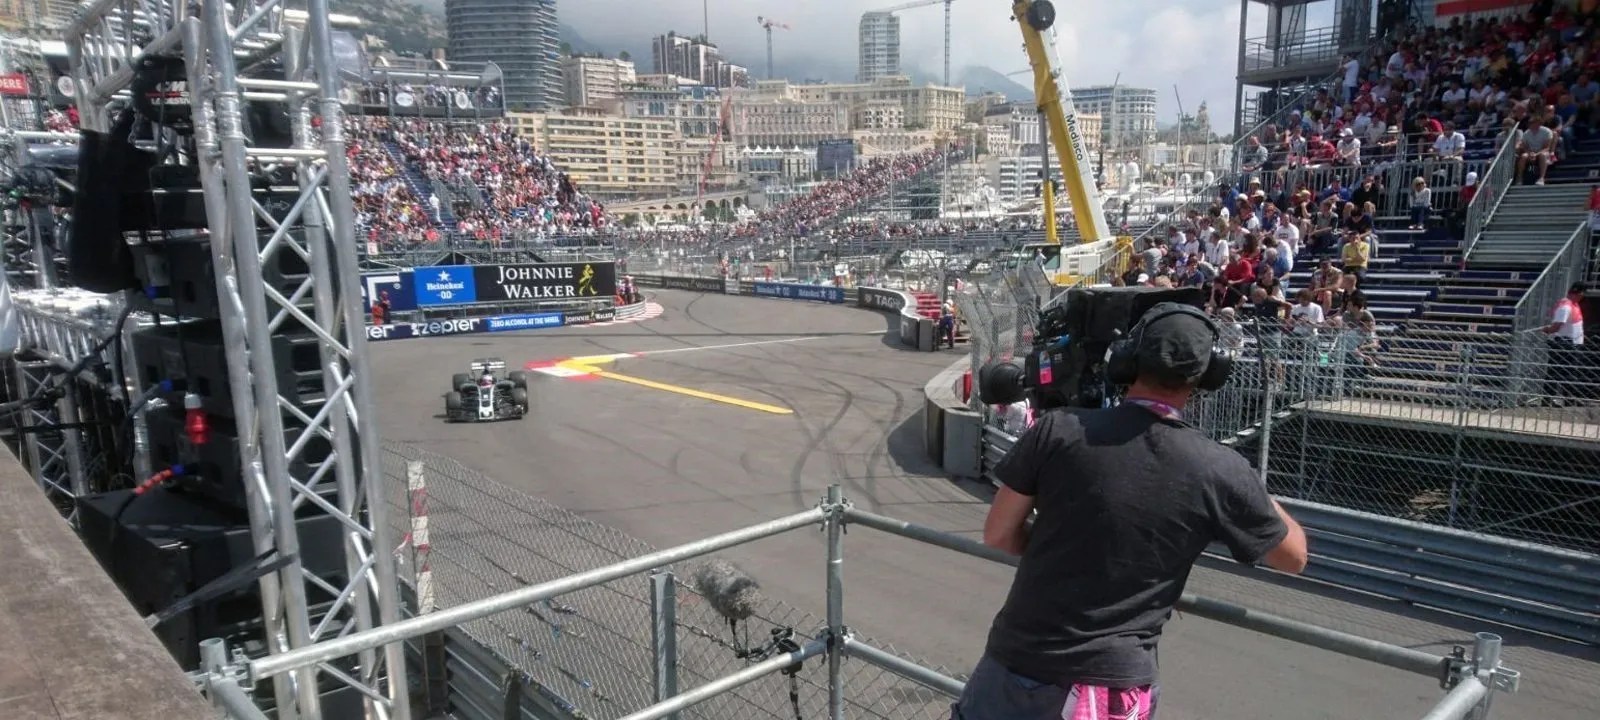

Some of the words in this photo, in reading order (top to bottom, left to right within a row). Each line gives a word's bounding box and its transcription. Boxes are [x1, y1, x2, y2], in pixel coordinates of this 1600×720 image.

[1065, 114, 1083, 161] Mediaco
[496, 265, 574, 284] JOHNNIE
[426, 281, 465, 291] Heineken
[503, 284, 576, 299] WALKER
[419, 318, 480, 334] zepter
[505, 319, 527, 327] ALCOHOL
